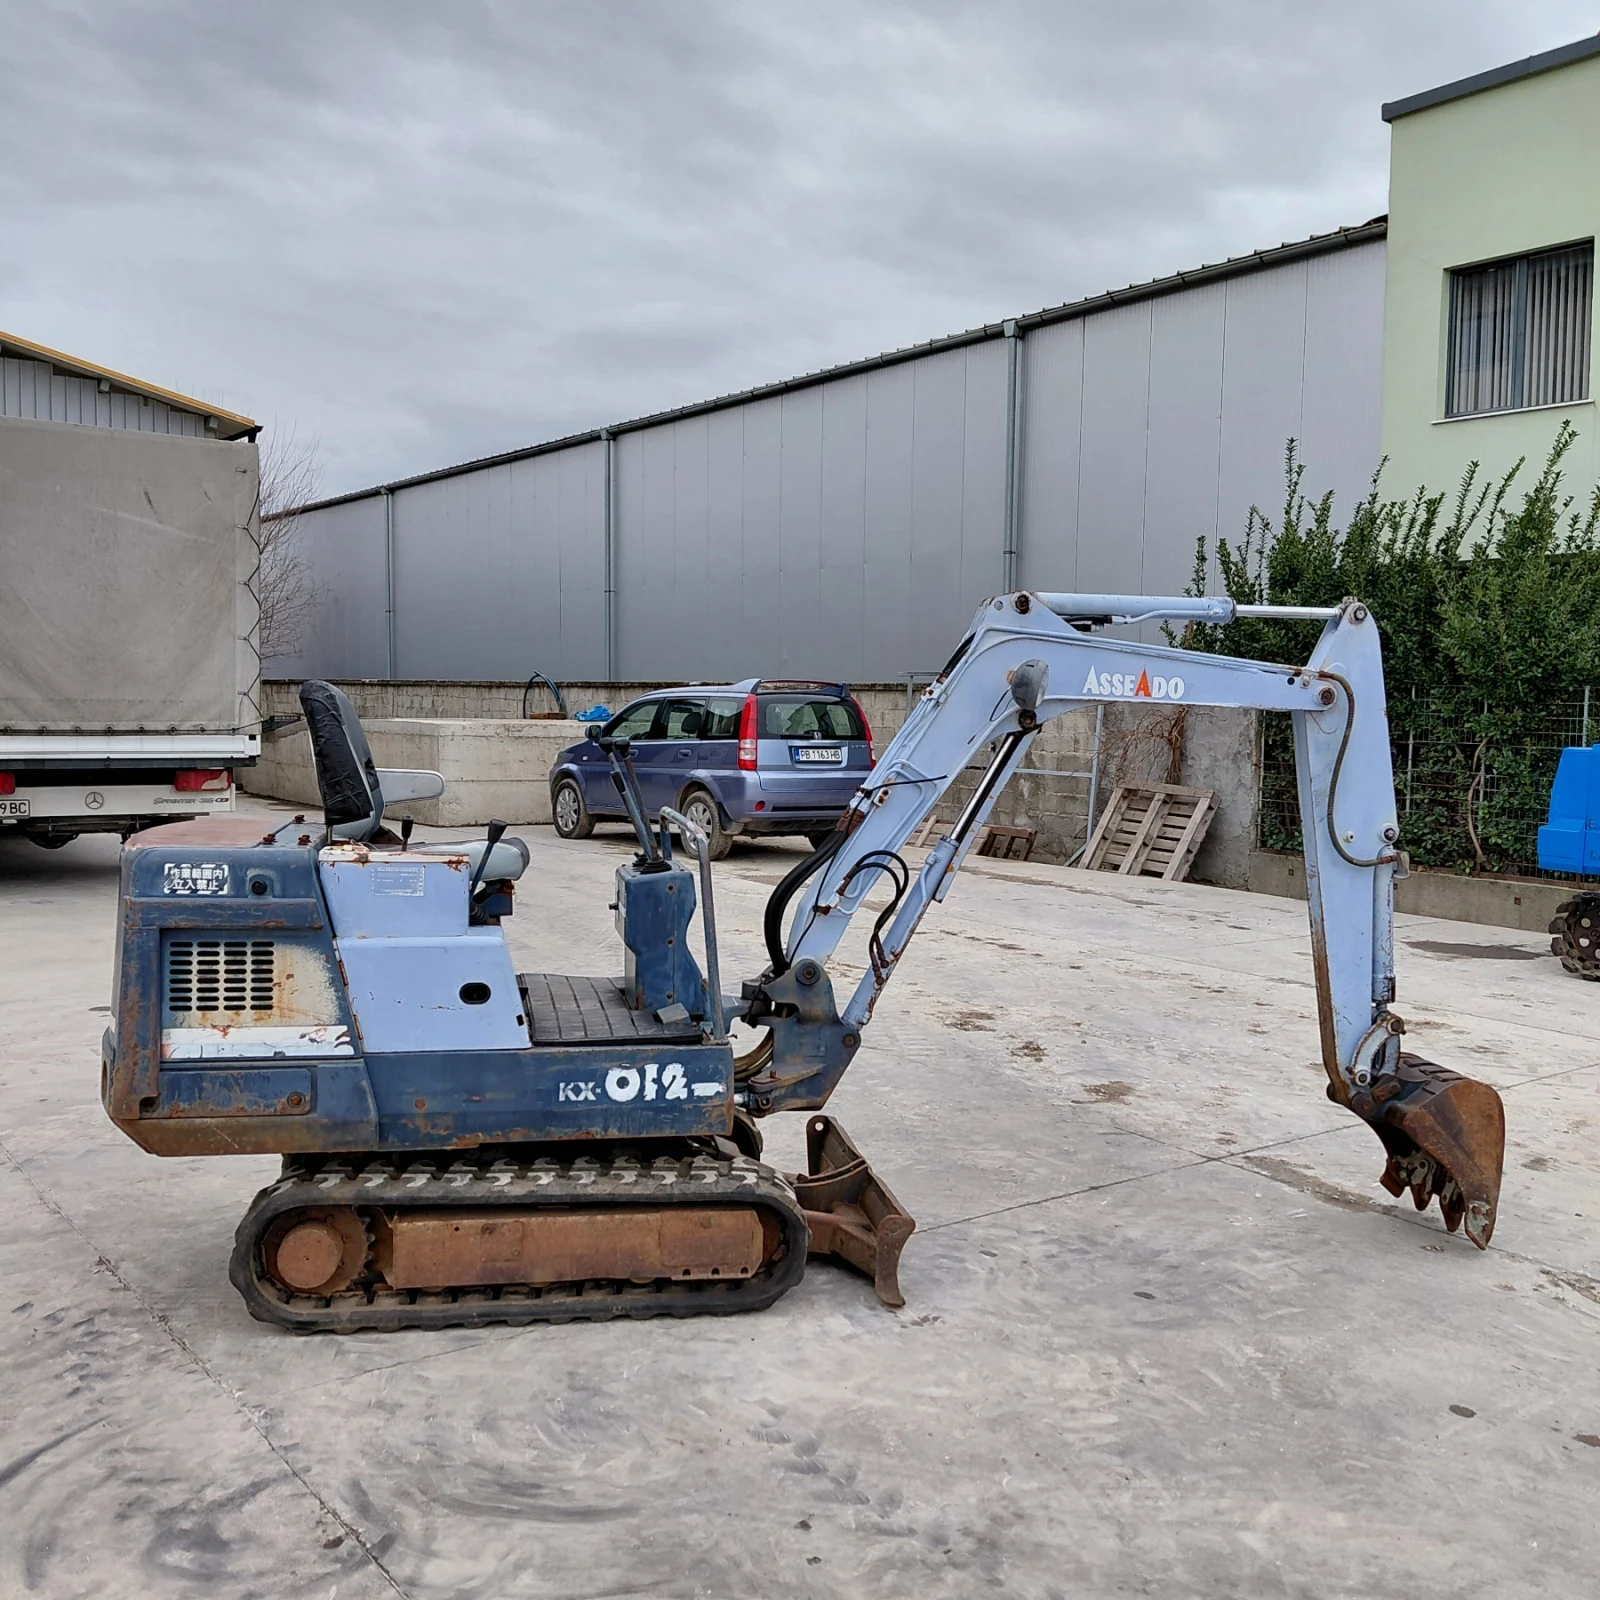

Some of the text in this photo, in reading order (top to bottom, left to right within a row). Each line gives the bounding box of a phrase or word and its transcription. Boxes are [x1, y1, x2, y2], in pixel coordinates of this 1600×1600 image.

[1082, 664, 1185, 699] ASSEADO
[800, 750, 841, 760] PB 1163 HB
[9, 802, 27, 815] BC
[172, 879, 219, 891] 立入禁止
